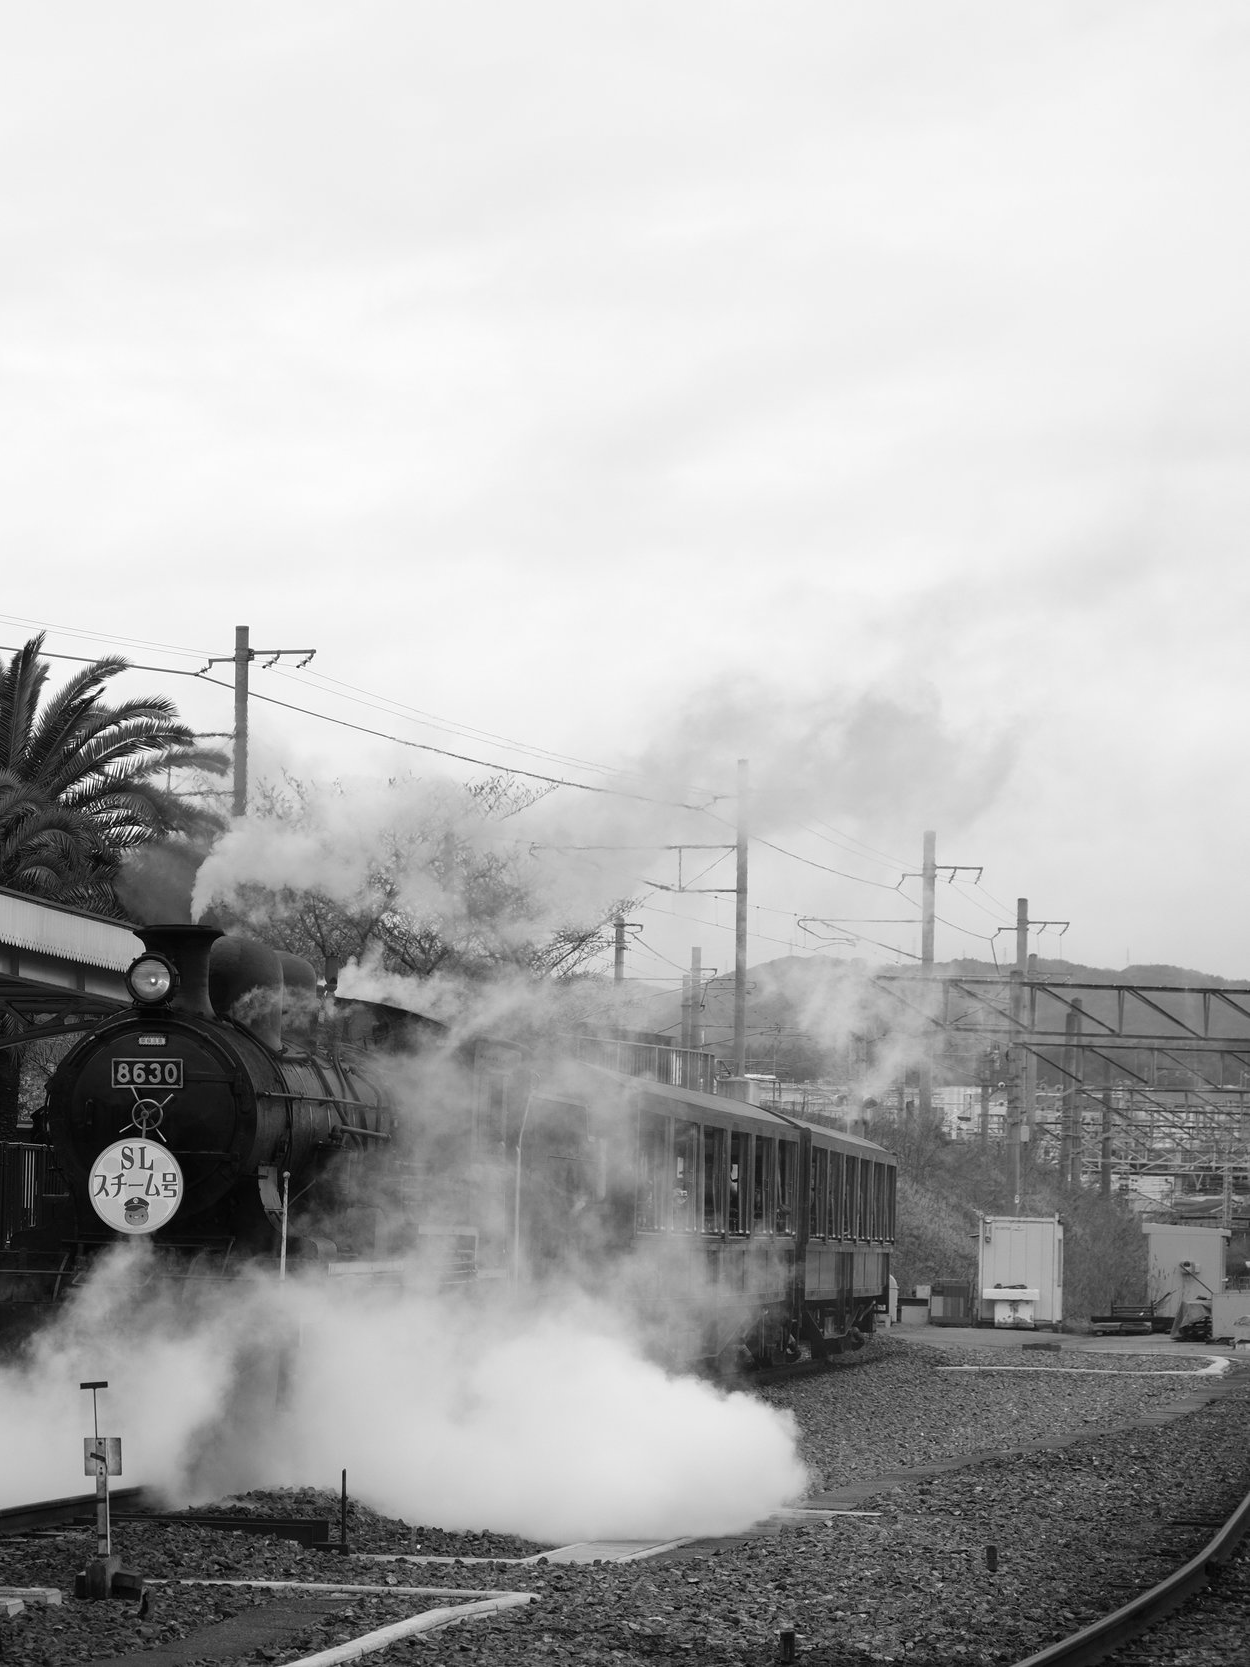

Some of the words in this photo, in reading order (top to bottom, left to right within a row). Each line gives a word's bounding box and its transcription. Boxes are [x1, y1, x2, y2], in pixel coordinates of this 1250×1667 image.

[116, 1062, 178, 1084] 8630
[120, 1145, 154, 1171] SL
[93, 1172, 178, 1198] スチーム号
